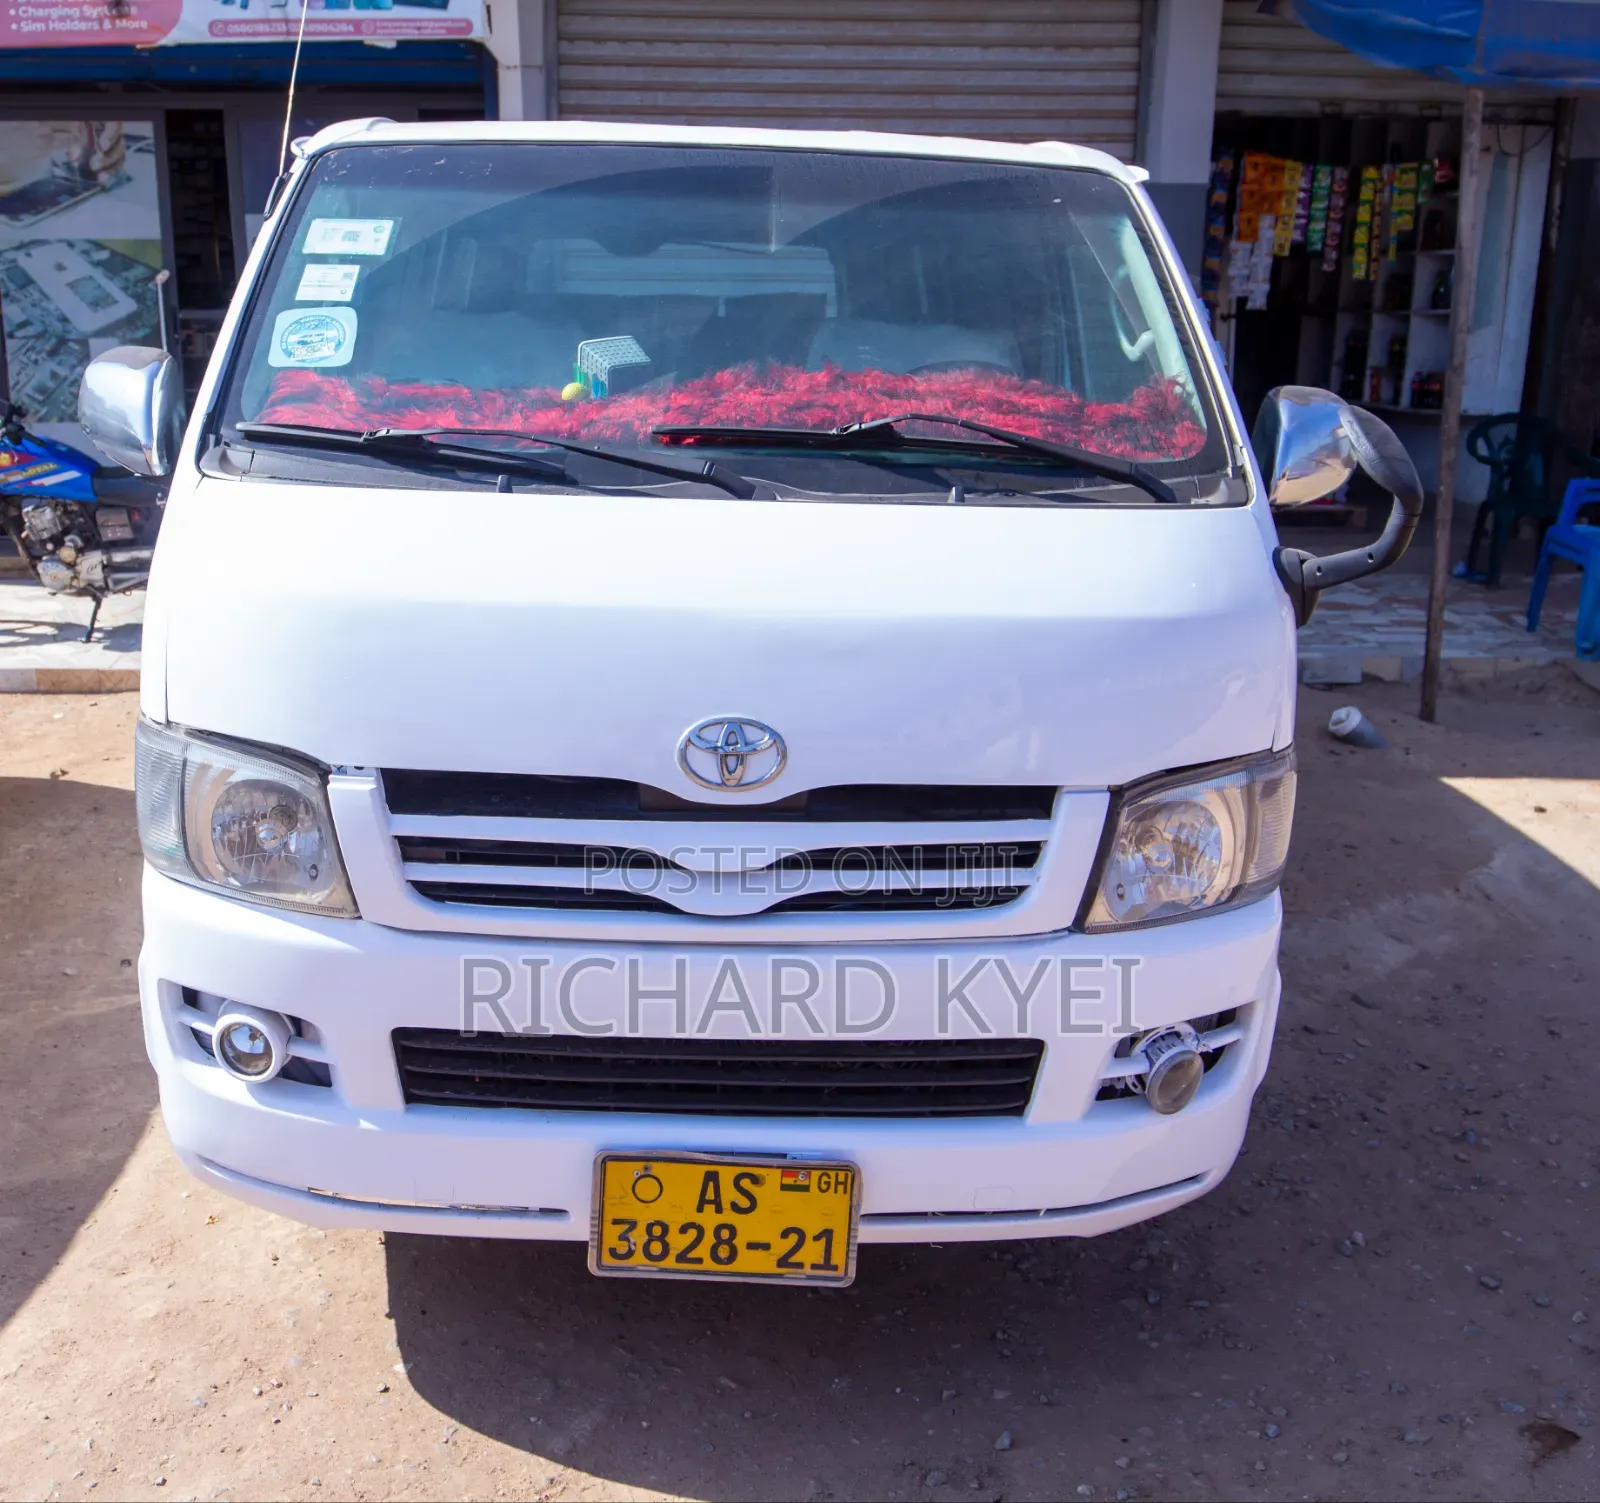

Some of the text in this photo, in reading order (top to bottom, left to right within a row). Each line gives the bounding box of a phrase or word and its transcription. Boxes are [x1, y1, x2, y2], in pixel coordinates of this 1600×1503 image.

[18, 5, 138, 19] Charging Systs
[20, 21, 45, 32] Sim
[49, 20, 99, 31] Holders
[116, 20, 148, 30] More
[696, 1170, 849, 1214] AS GH
[608, 1218, 839, 1271] 3828-21
